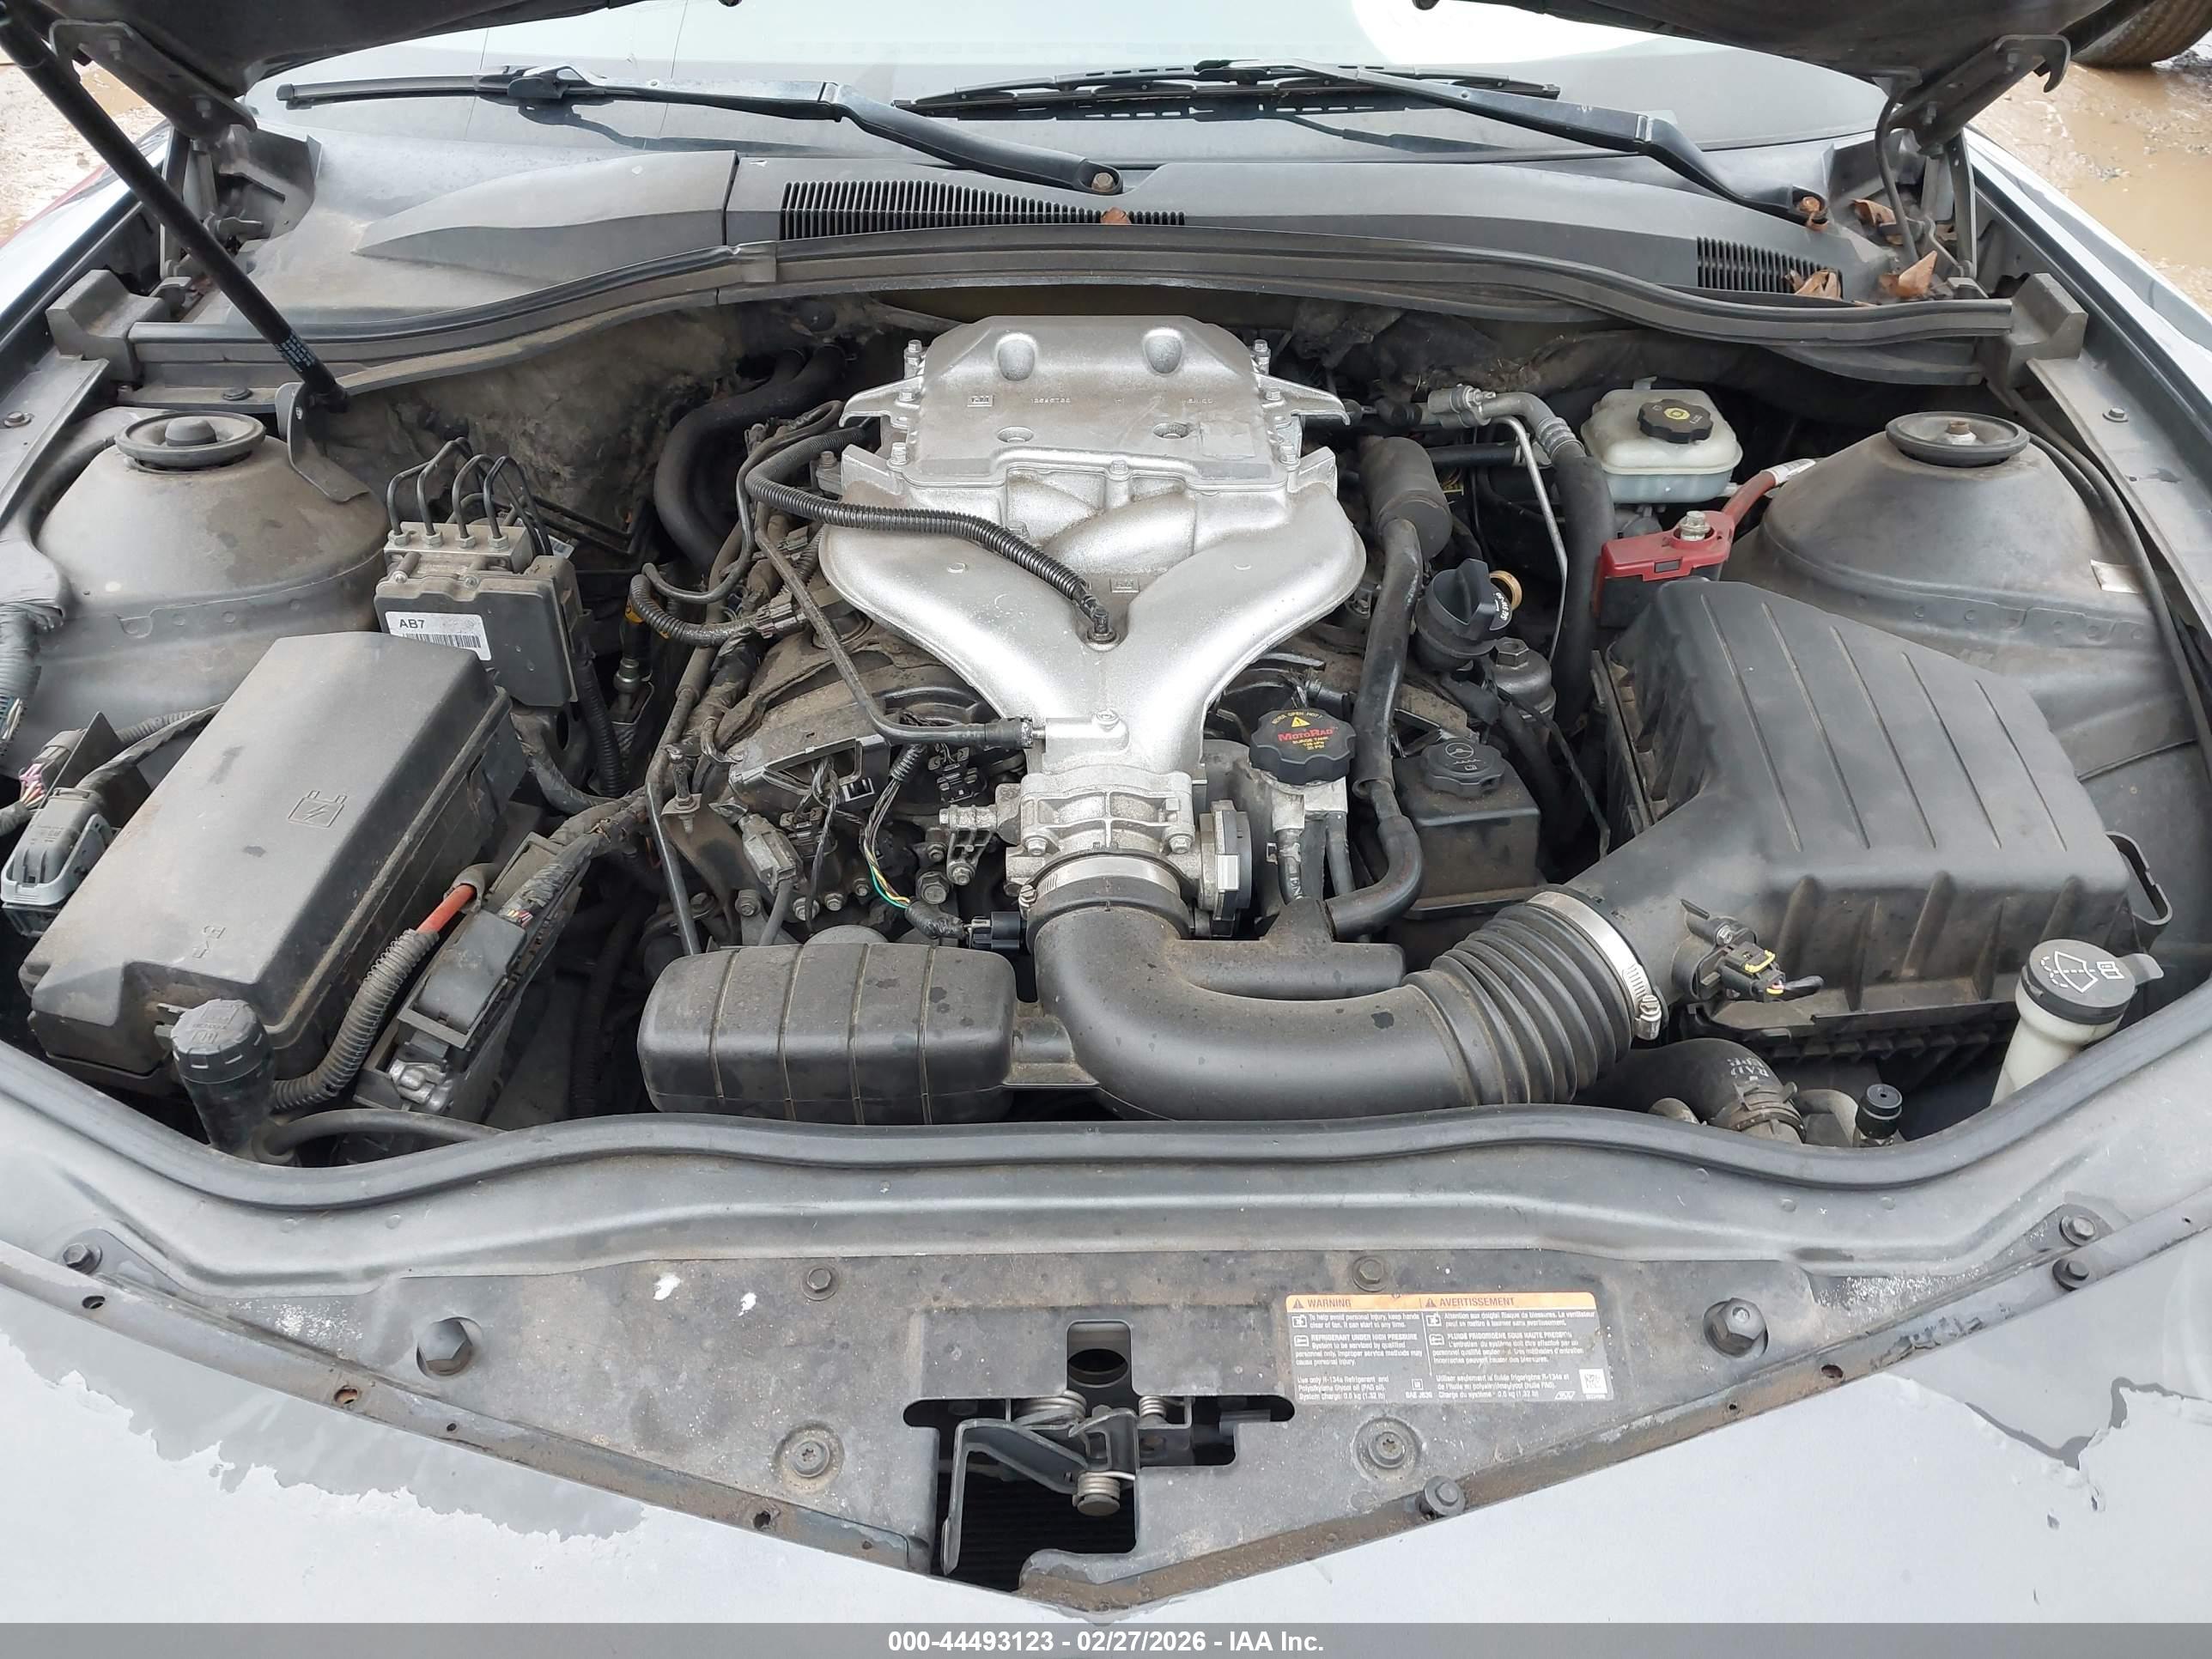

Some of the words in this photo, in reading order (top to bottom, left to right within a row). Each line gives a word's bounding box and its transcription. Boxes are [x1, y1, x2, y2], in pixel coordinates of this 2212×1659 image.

[399, 619, 425, 629] AB7
[1307, 1298, 1352, 1308] WARNING
[1439, 1297, 1515, 1306] AVERTISSEMENT
